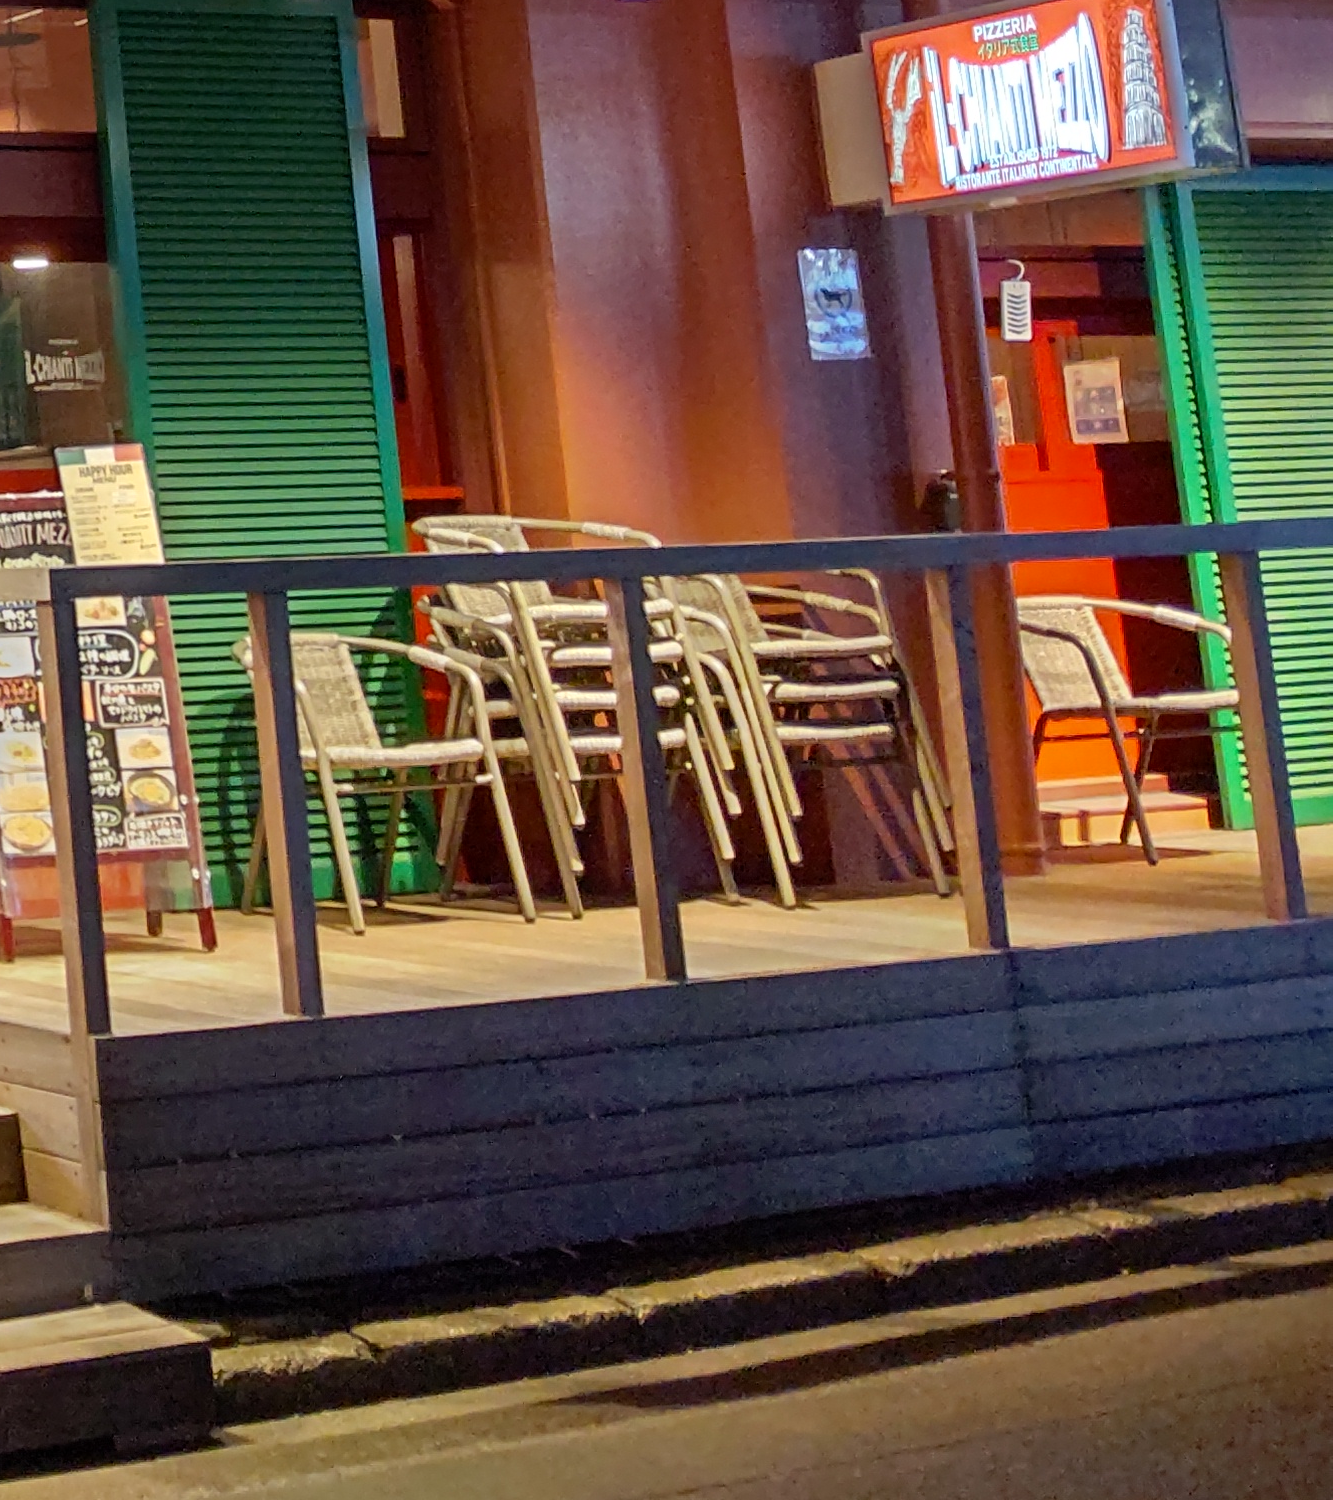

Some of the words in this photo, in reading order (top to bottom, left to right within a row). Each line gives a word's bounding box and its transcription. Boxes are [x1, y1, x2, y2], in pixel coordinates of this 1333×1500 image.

[973, 14, 1037, 42] PIZZERIA
[989, 150, 1040, 168] ESTABLISHED
[955, 171, 1001, 191] RISTORANTE
[1002, 165, 1038, 185] ITALIANO
[1039, 154, 1099, 179] CONTINENTALE
[78, 465, 107, 478] HAPPY
[109, 464, 133, 476] HOUR
[36, 520, 72, 546] MEZ
